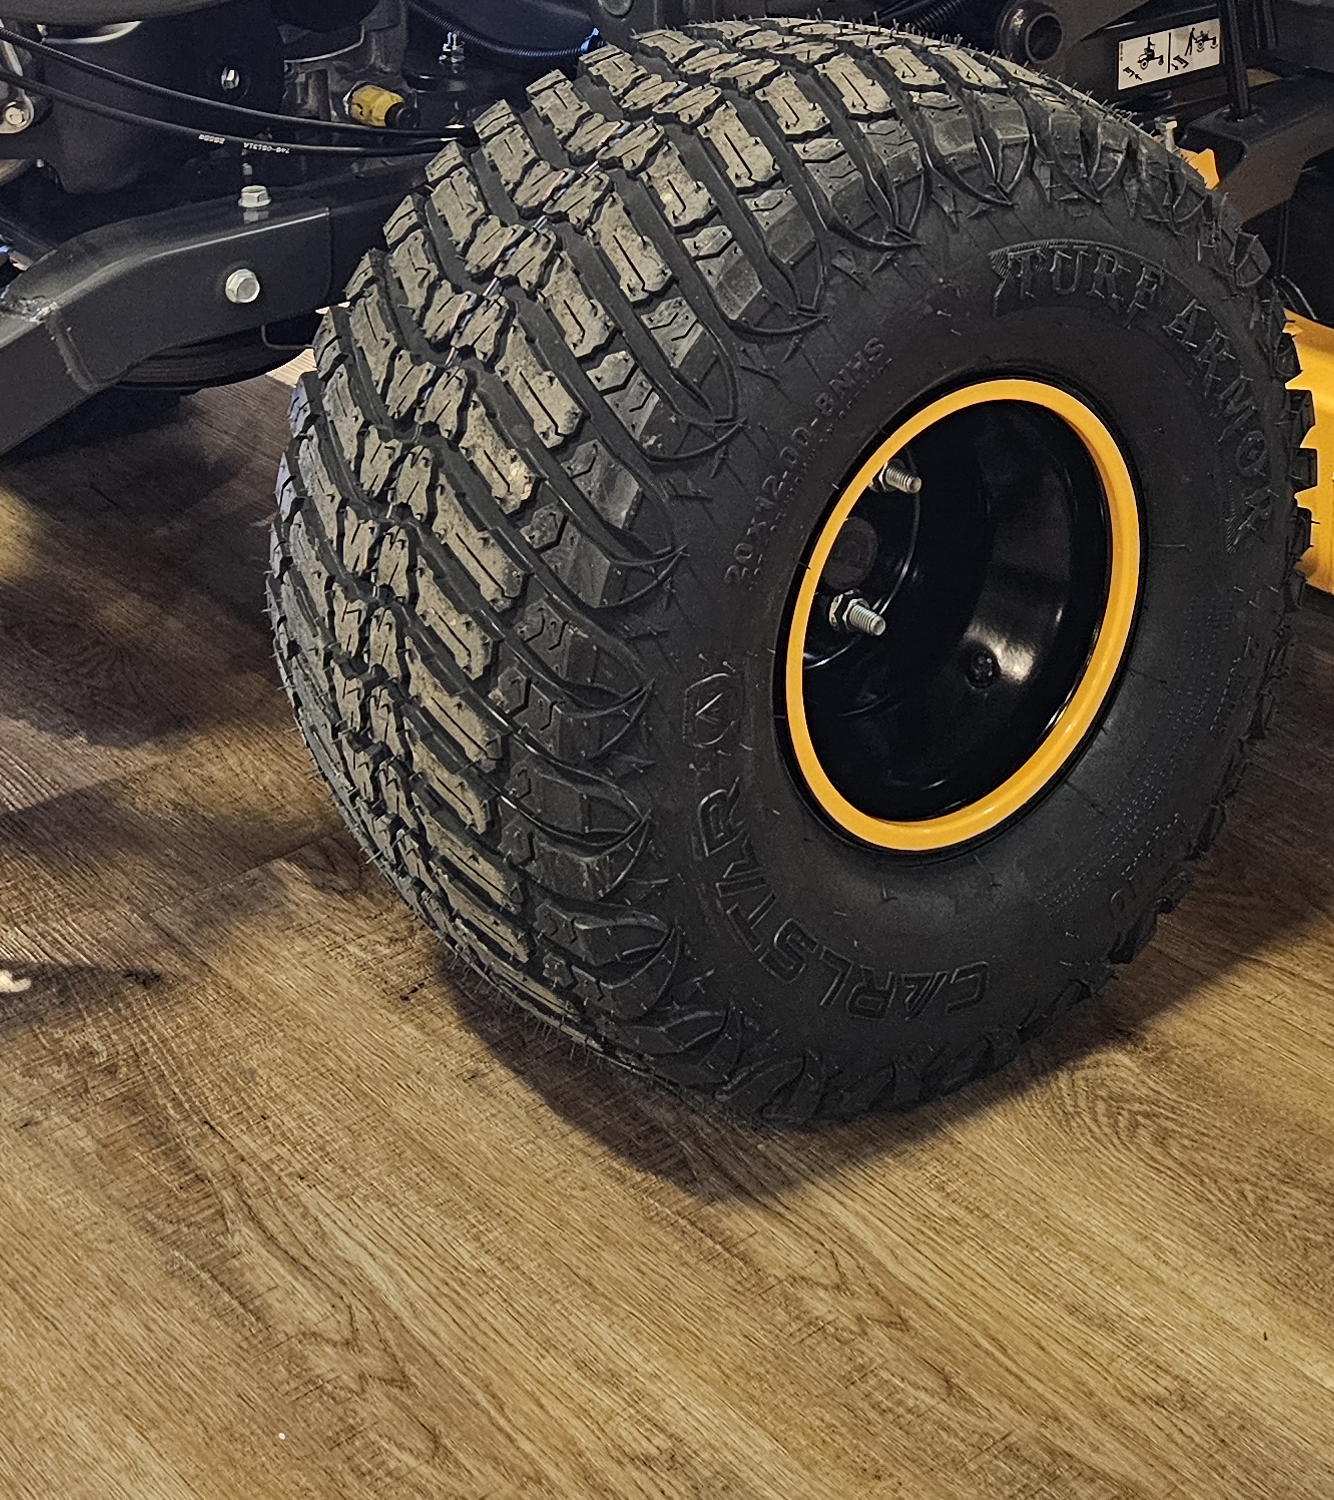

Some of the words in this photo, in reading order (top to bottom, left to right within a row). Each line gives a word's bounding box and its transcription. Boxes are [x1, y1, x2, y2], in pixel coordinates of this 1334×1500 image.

[1003, 243, 1165, 329] TURF
[1162, 298, 1280, 552] ARMOR
[696, 775, 989, 1021] CARLSTAR
